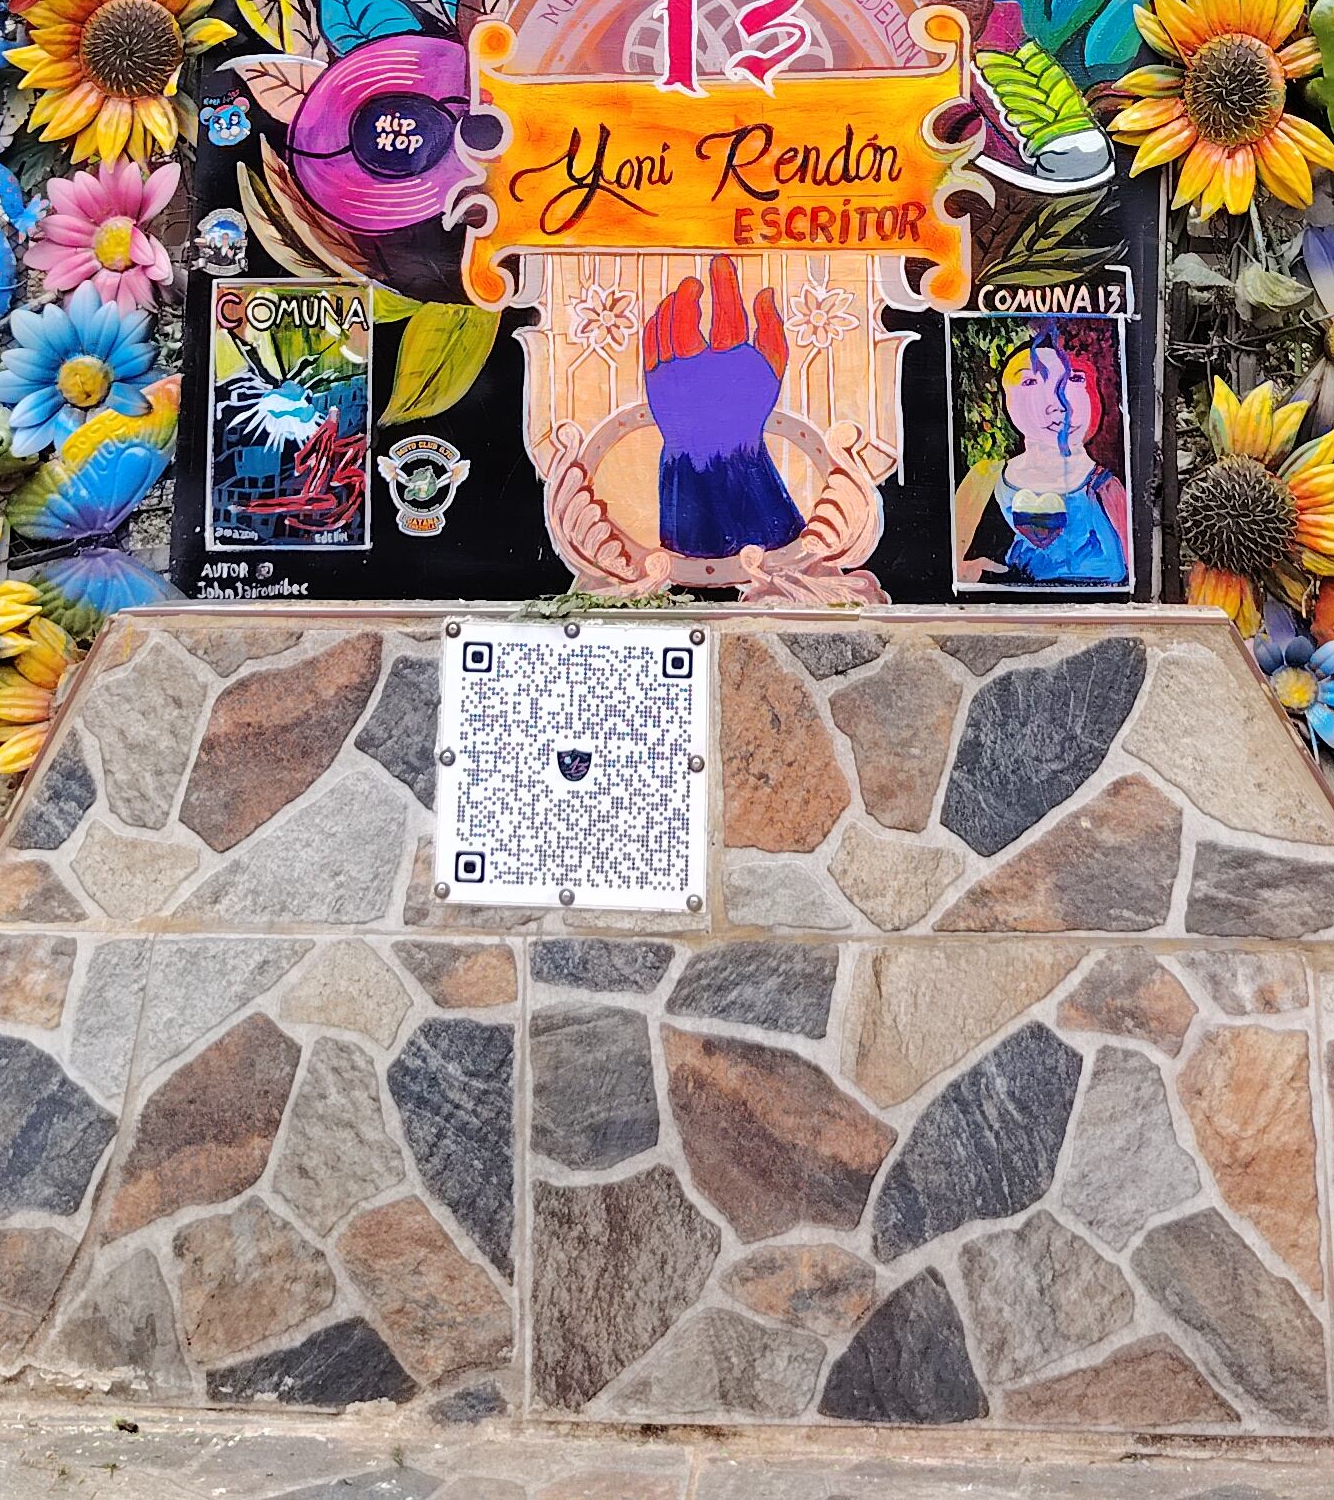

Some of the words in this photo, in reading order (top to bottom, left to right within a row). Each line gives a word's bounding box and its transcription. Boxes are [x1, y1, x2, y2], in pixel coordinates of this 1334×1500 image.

[509, 121, 674, 237] Yoni
[695, 122, 903, 203] Rendón
[215, 291, 370, 331] COMUNA
[977, 283, 1093, 314] COMUNA
[1097, 284, 1122, 314] 13
[201, 561, 249, 579] AUTOR
